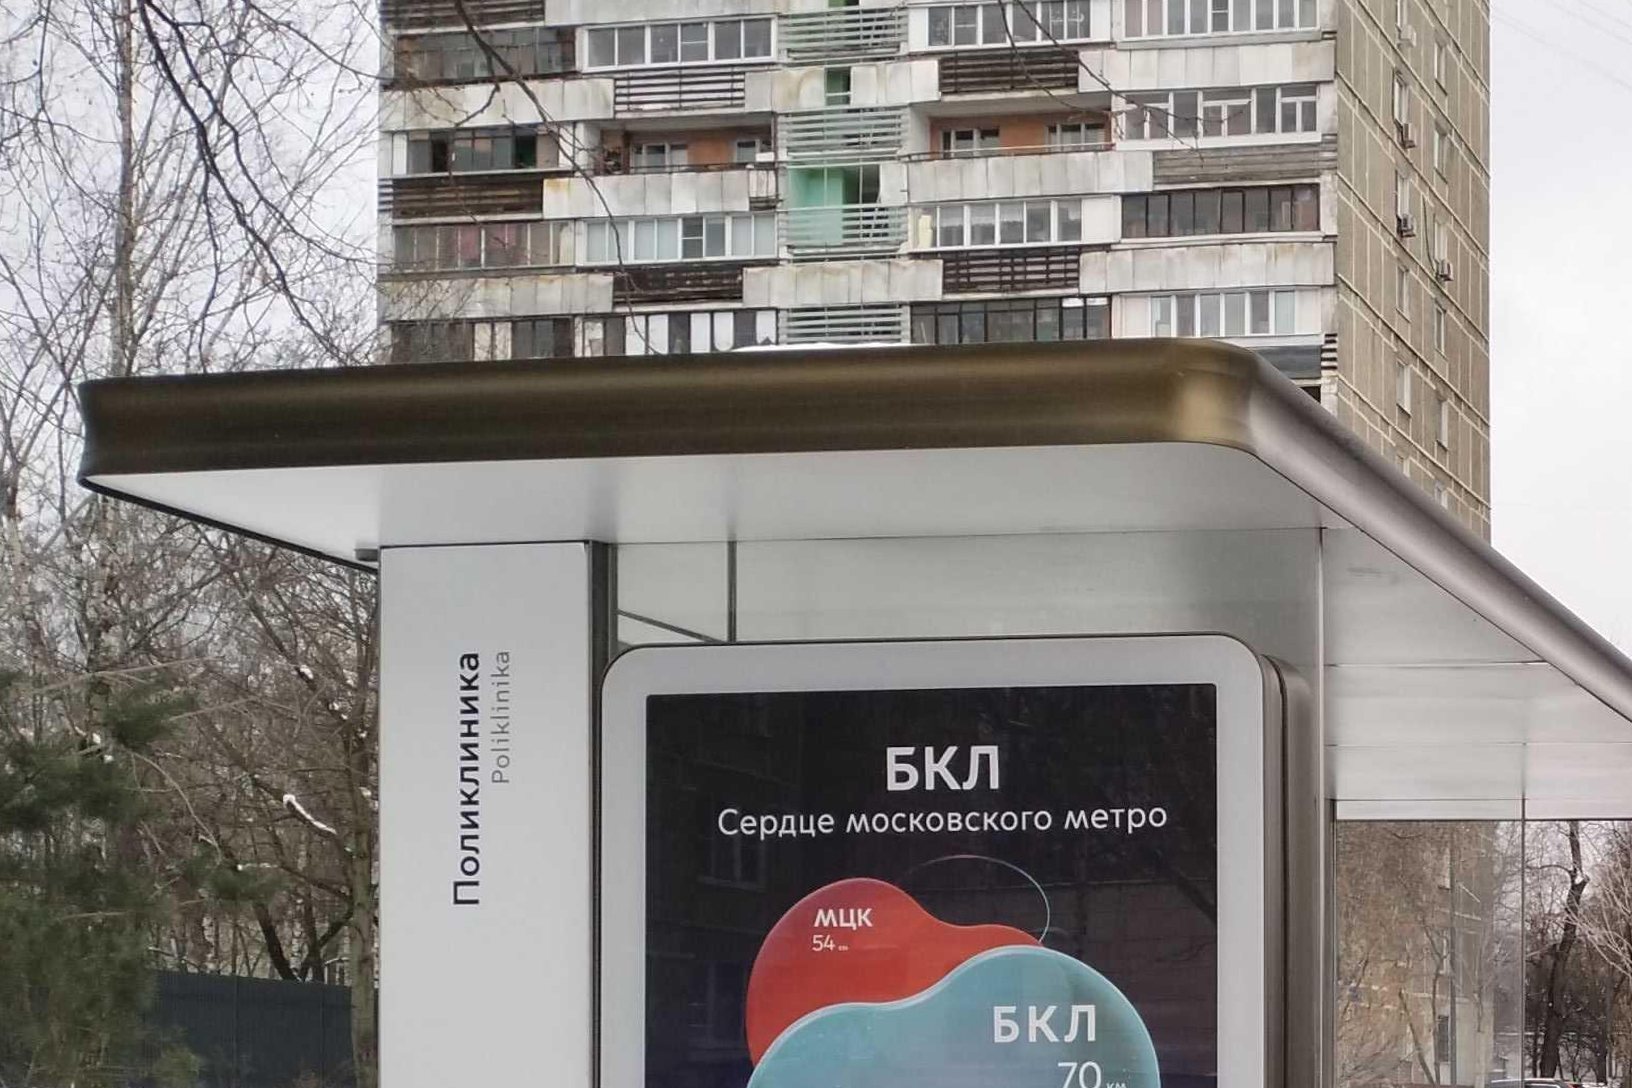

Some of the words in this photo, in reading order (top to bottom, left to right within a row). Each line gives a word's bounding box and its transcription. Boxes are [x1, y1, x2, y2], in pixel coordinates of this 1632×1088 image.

[490, 651, 510, 784] Poliklinika
[453, 651, 480, 905] Поликлиника
[885, 745, 1001, 792] БКЛ
[717, 808, 835, 841] Сердце
[846, 809, 1053, 834] московского
[1064, 806, 1168, 834] метро
[813, 908, 874, 931] МЦК
[811, 934, 836, 952] 54
[992, 1004, 1096, 1043] БКЛ
